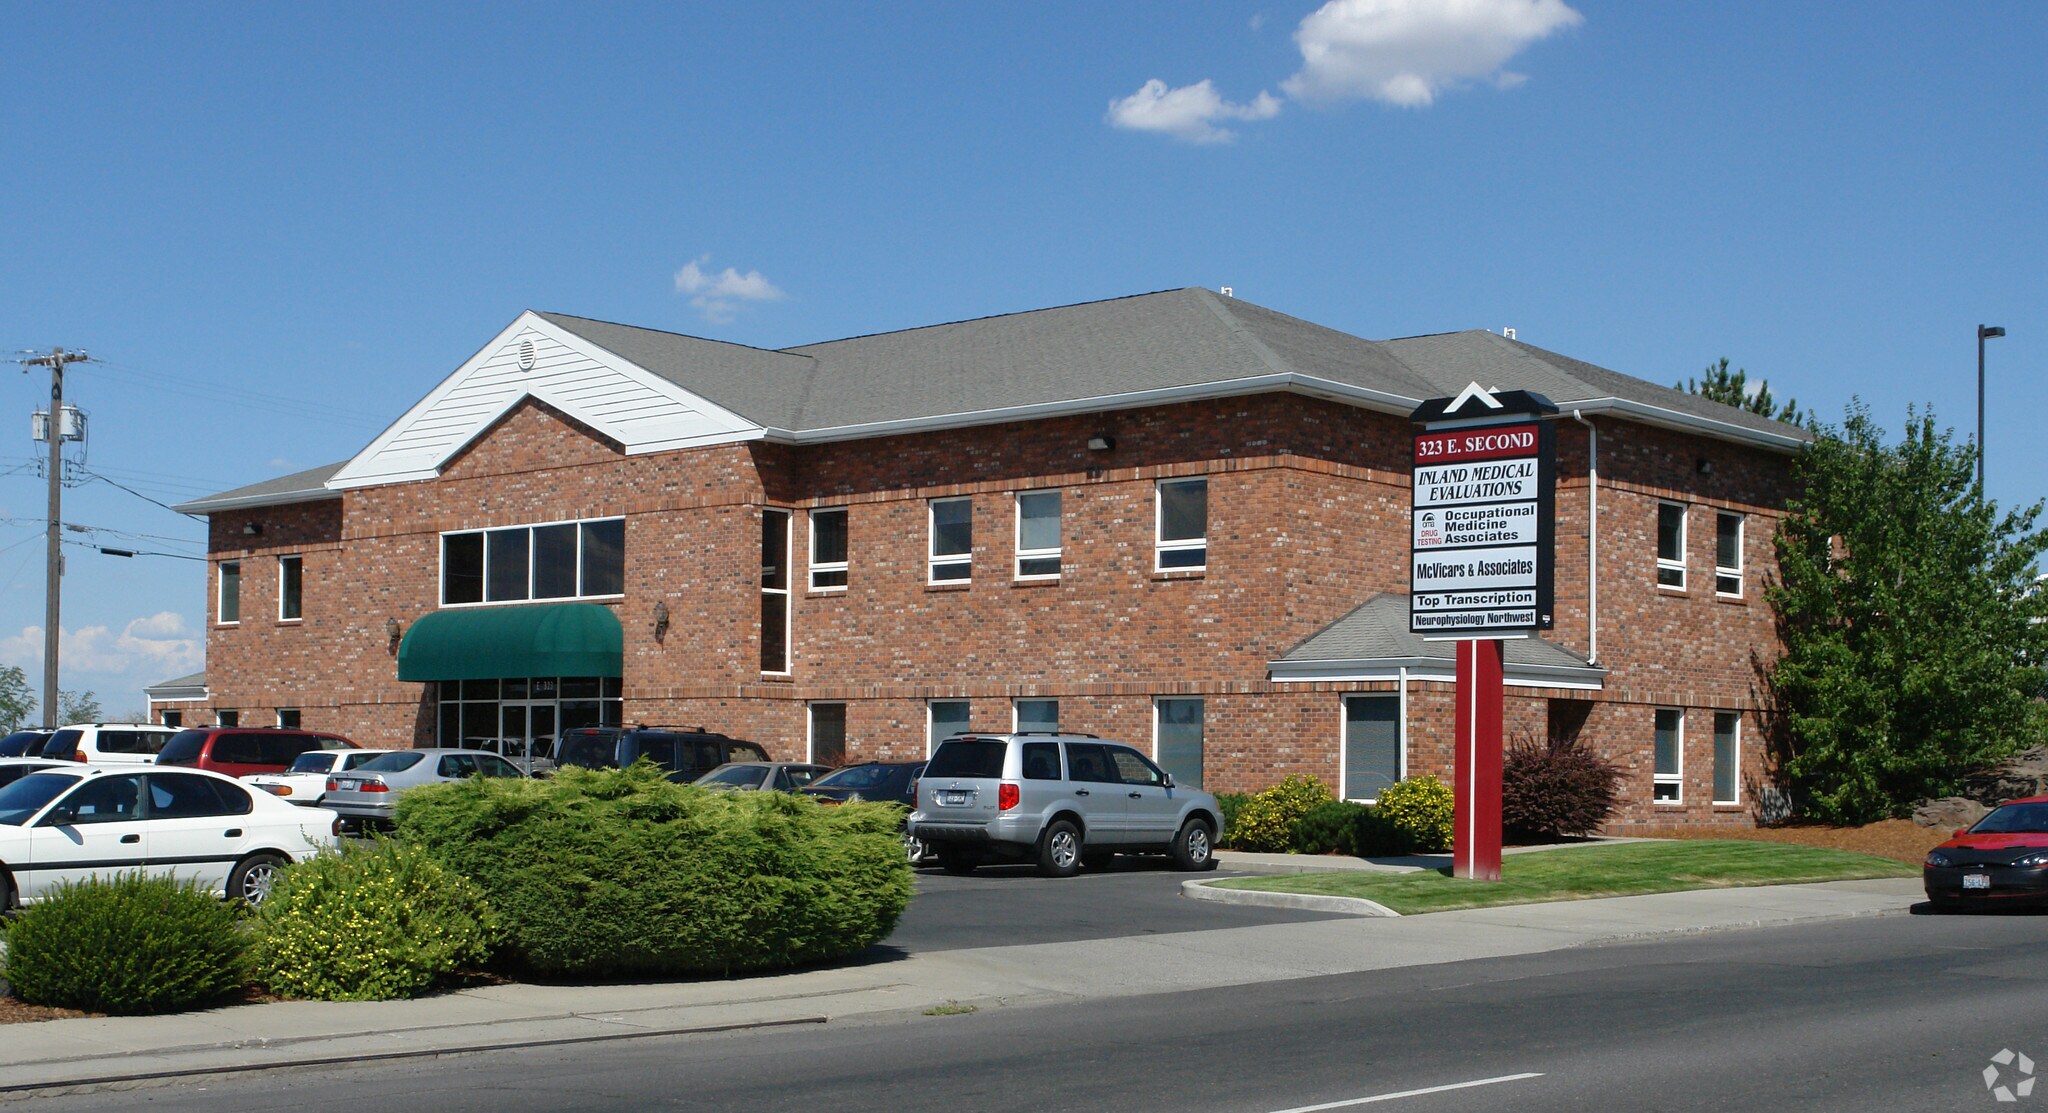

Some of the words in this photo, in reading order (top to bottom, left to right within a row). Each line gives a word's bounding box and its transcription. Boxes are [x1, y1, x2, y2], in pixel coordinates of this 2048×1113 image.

[1419, 441, 1442, 456] 323
[1447, 439, 1461, 454] E.
[1465, 432, 1534, 452] SECOND
[1418, 469, 1468, 485] INLAND
[1471, 463, 1534, 481] MEDICAL
[1429, 481, 1522, 501] EVALUATIONS
[1445, 505, 1535, 521] Occupational
[1445, 520, 1507, 532] Medicine
[1417, 537, 1442, 546] TESTING
[1445, 531, 1519, 544] Associates
[1417, 563, 1465, 579] McVicars
[1468, 563, 1474, 577] &
[1477, 559, 1533, 576] Associates
[1417, 596, 1440, 608] Top
[1444, 592, 1532, 605] Transcription
[1415, 614, 1485, 627] Neurophysiology
[1487, 611, 1534, 624] Northwest
